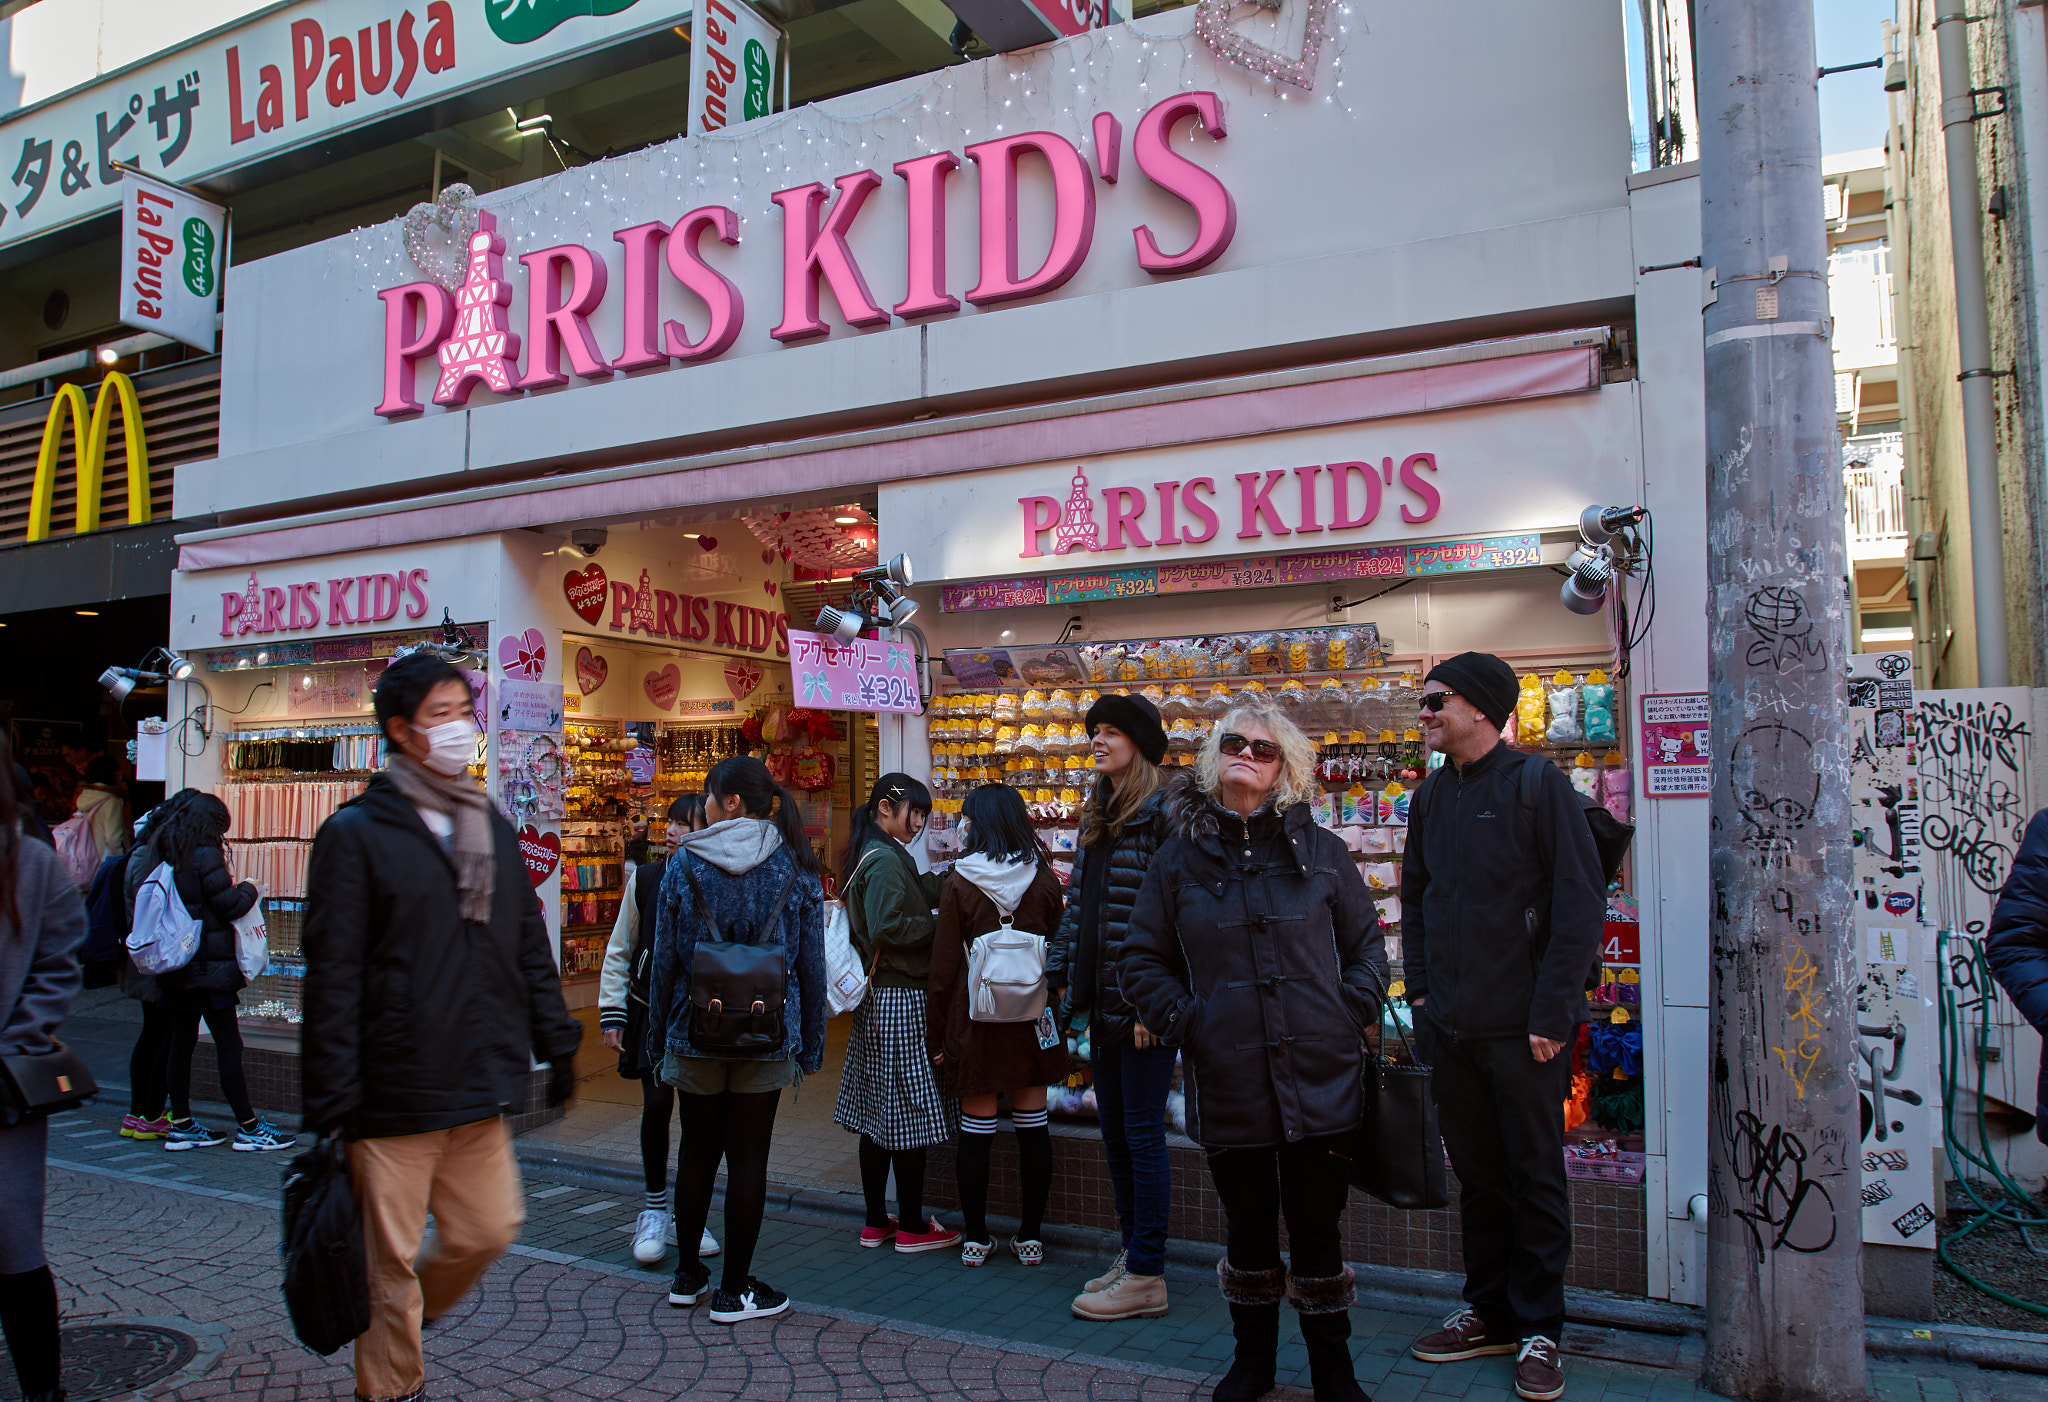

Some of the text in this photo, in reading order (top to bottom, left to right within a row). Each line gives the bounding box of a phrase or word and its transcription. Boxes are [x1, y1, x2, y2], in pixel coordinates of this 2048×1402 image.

[751, 46, 763, 120] ラパウ
[0, 70, 200, 228] タ&ピザ
[375, 91, 1238, 418] PARIS KID'S
[1018, 452, 1442, 559] PARIS KID'S
[1281, 552, 1404, 576] アクセサリー ¥324
[1410, 542, 1540, 567] アクセサリー ¥324
[1050, 573, 1156, 596] アクセサリー ¥324
[1160, 562, 1275, 587] アクセサリー ¥324
[219, 568, 430, 637] PARIS KID'S
[609, 568, 710, 641] PARIS
[714, 601, 790, 655] KID'S
[1005, 588, 1046, 606] ¥324
[288, 647, 312, 660] ¥324
[348, 647, 371, 659] ¥324
[793, 638, 883, 671] アクセサリー
[712, 700, 734, 712] ¥324
[857, 673, 918, 710] ¥324
